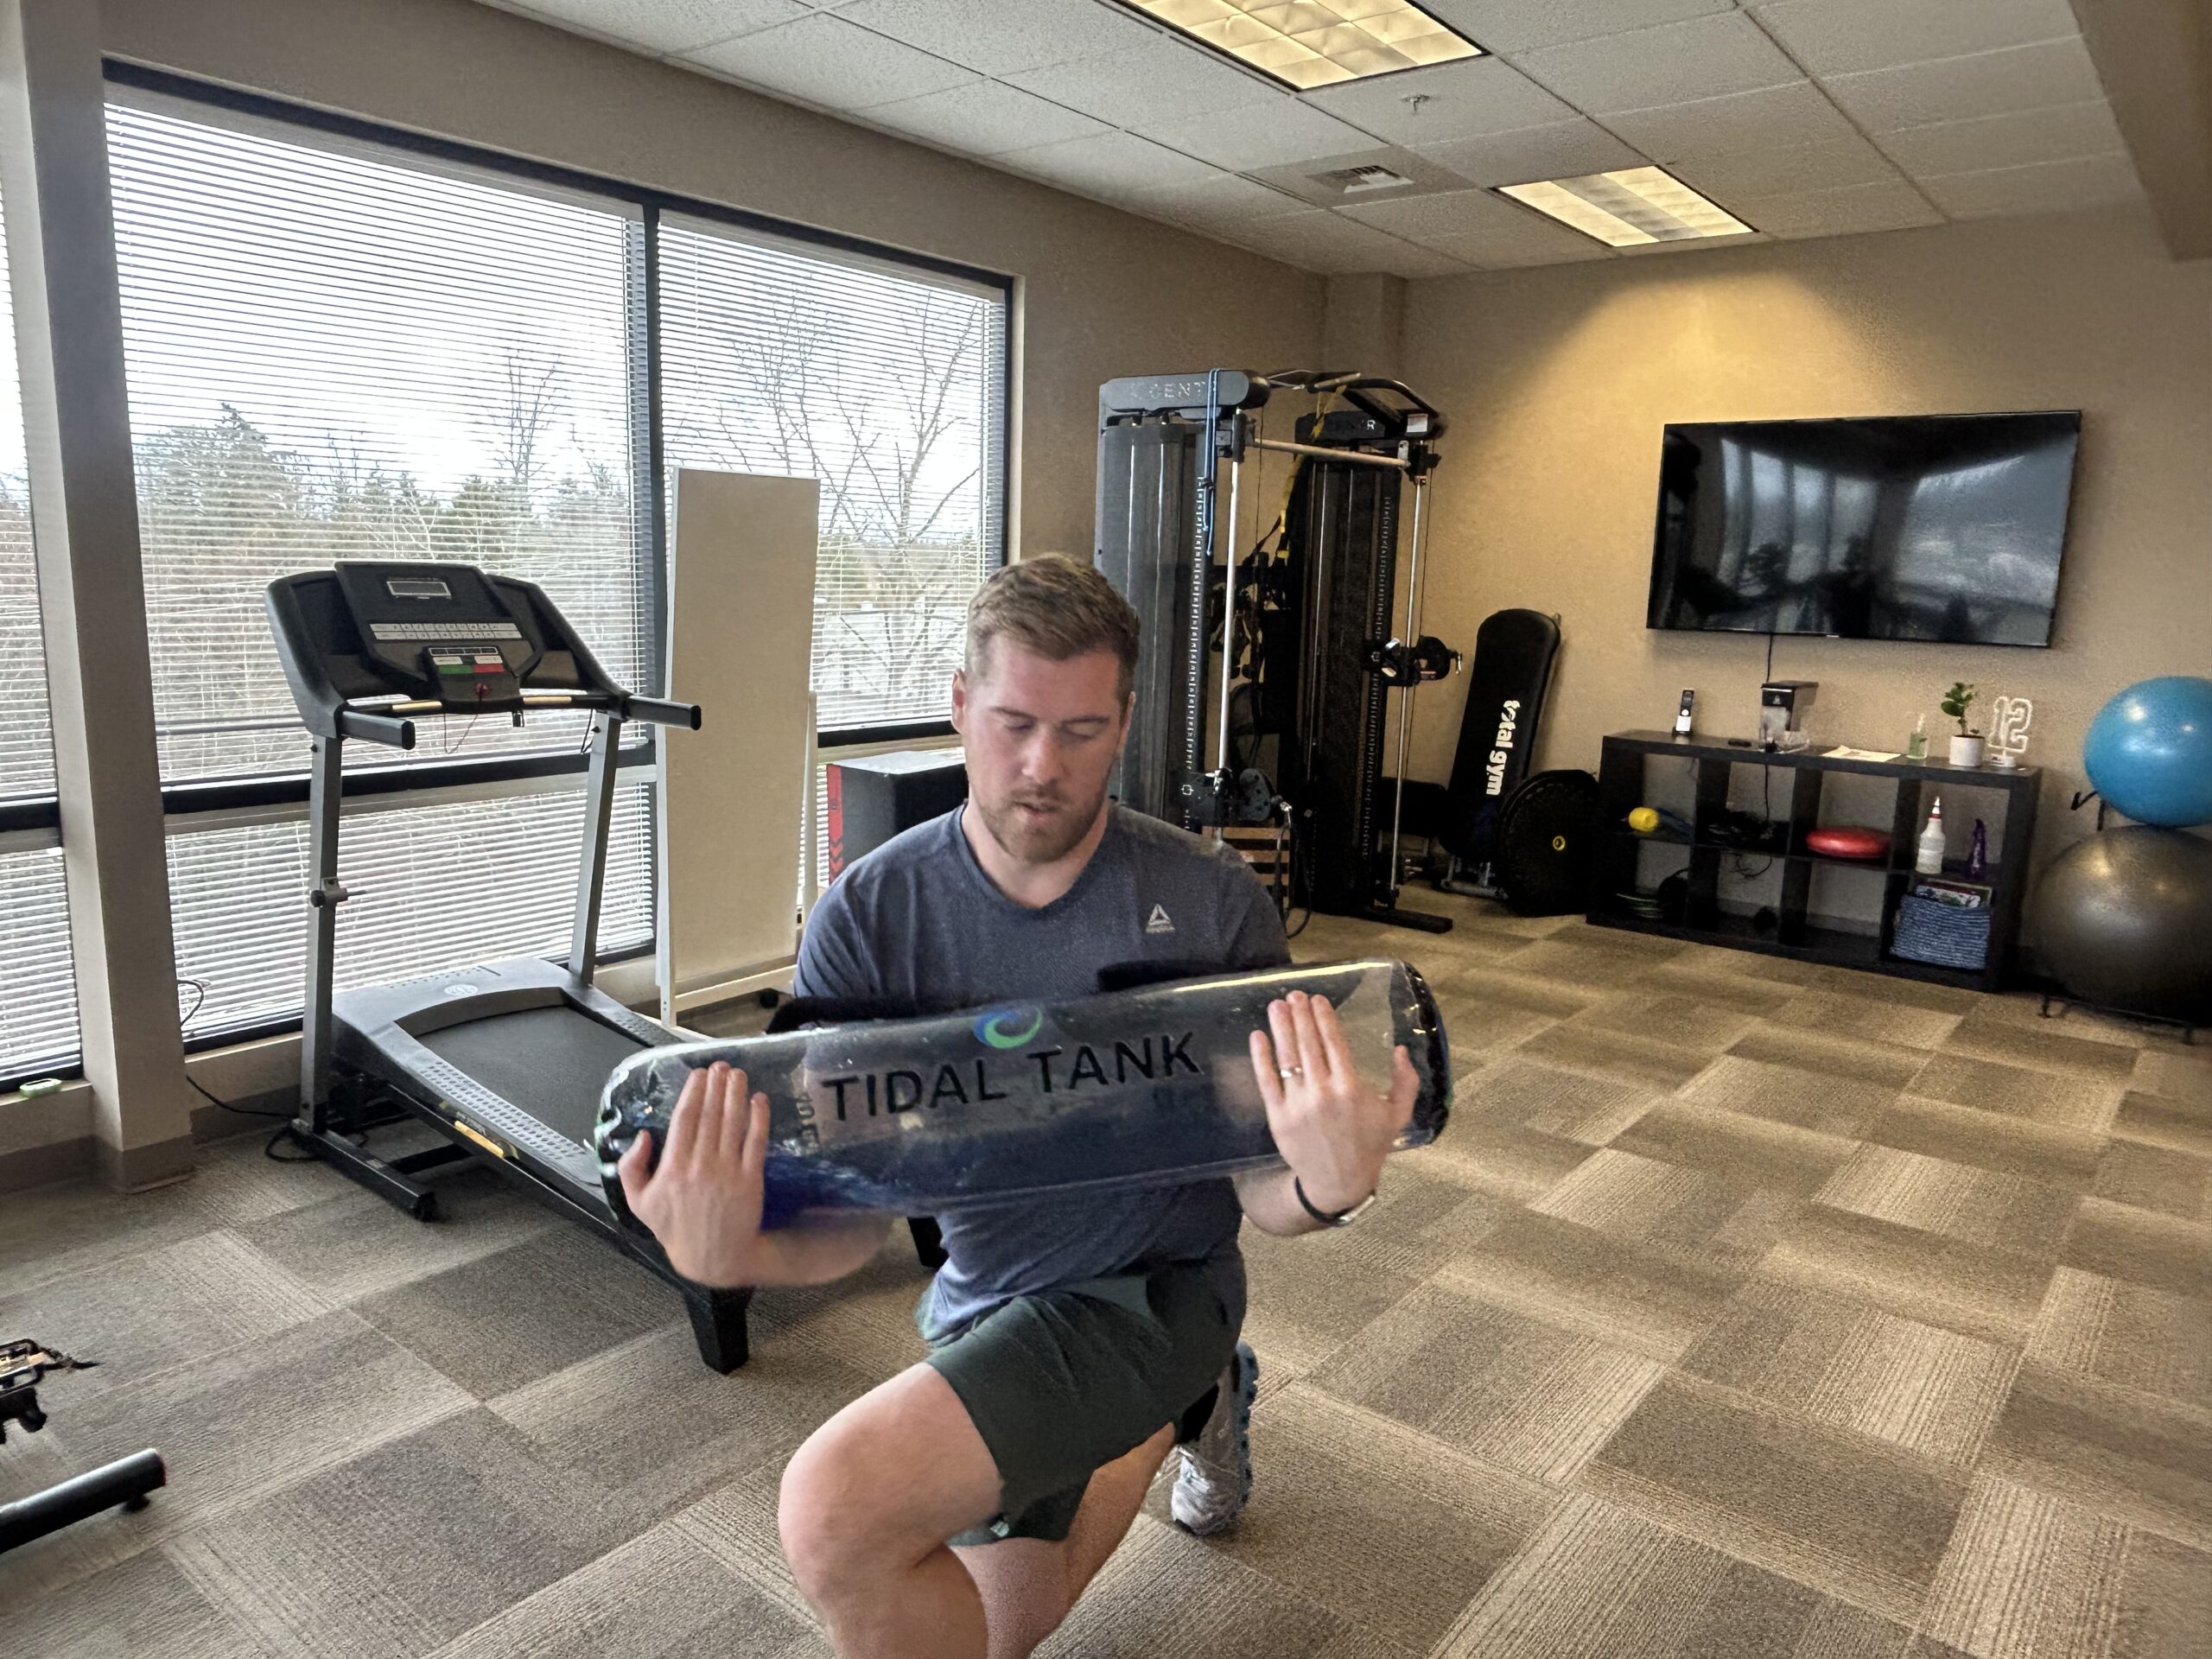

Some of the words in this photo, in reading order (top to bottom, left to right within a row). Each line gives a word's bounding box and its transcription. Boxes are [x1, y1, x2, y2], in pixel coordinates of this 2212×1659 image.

[1495, 700, 1521, 747] total
[1485, 750, 1507, 795] gym
[822, 1059, 1007, 1122] TIDAL
[1027, 1032, 1201, 1094] TANK
